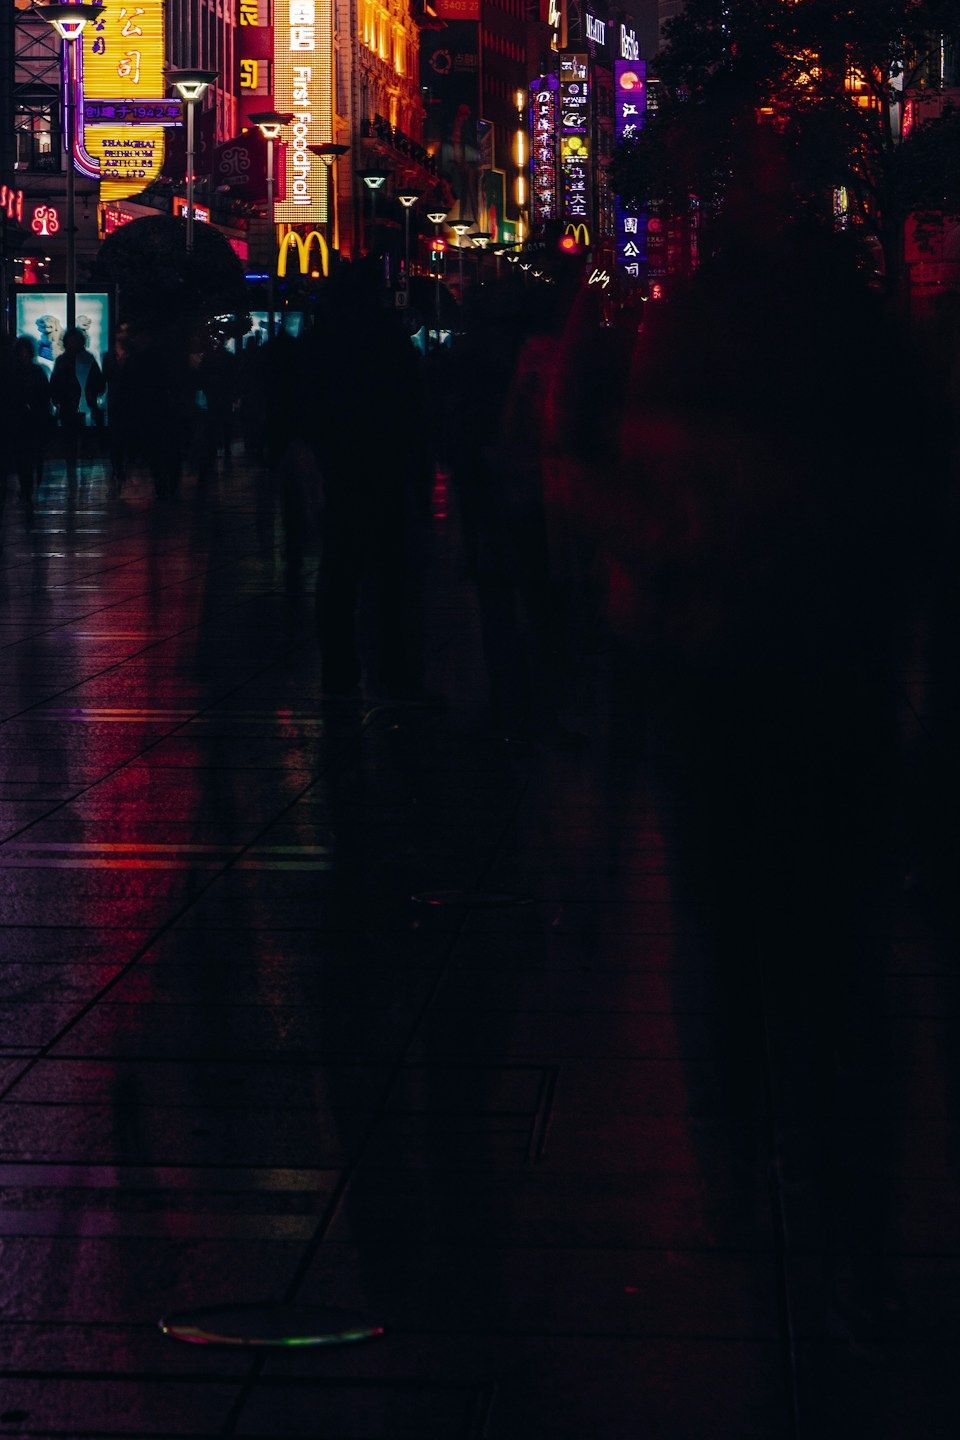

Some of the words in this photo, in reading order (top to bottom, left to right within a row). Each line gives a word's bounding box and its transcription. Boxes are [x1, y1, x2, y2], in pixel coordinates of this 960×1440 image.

[292, 66, 312, 107] First
[101, 139, 155, 148] SHANGHAI
[292, 112, 312, 206] Foodhall
